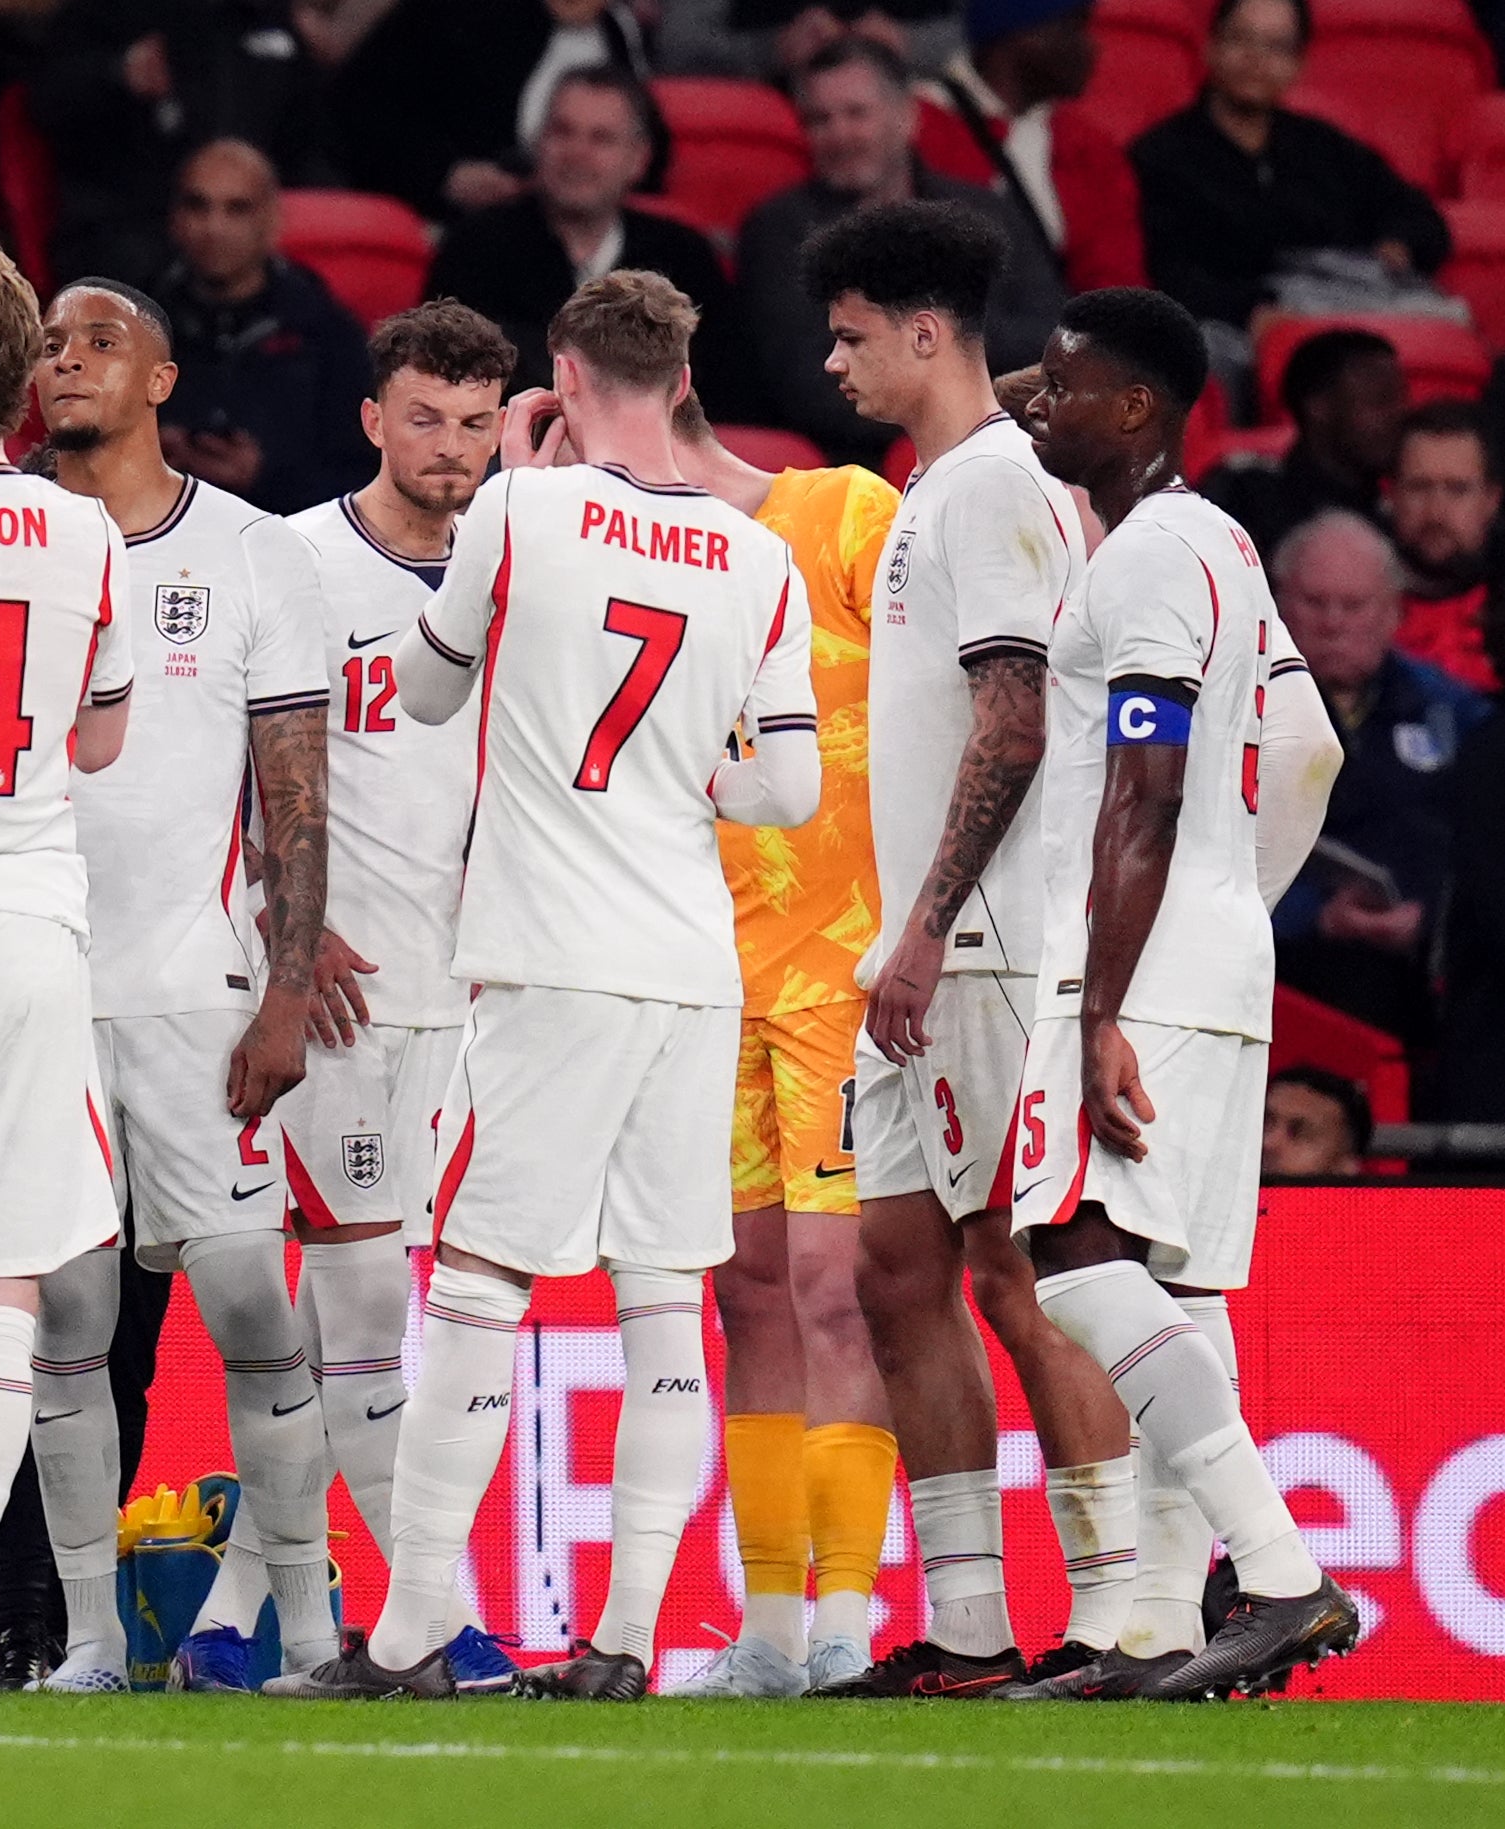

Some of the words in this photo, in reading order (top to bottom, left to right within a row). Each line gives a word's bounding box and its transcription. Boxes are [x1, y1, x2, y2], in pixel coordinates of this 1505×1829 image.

[580, 500, 729, 572] PALMER
[166, 653, 196, 663] JAPAN
[342, 655, 398, 733] 12
[573, 597, 688, 792] 7
[1118, 697, 1157, 739] C
[934, 1077, 964, 1156] 3
[1022, 1090, 1045, 1169] 5
[467, 1392, 509, 1412] ENG
[652, 1378, 700, 1394] ENG
